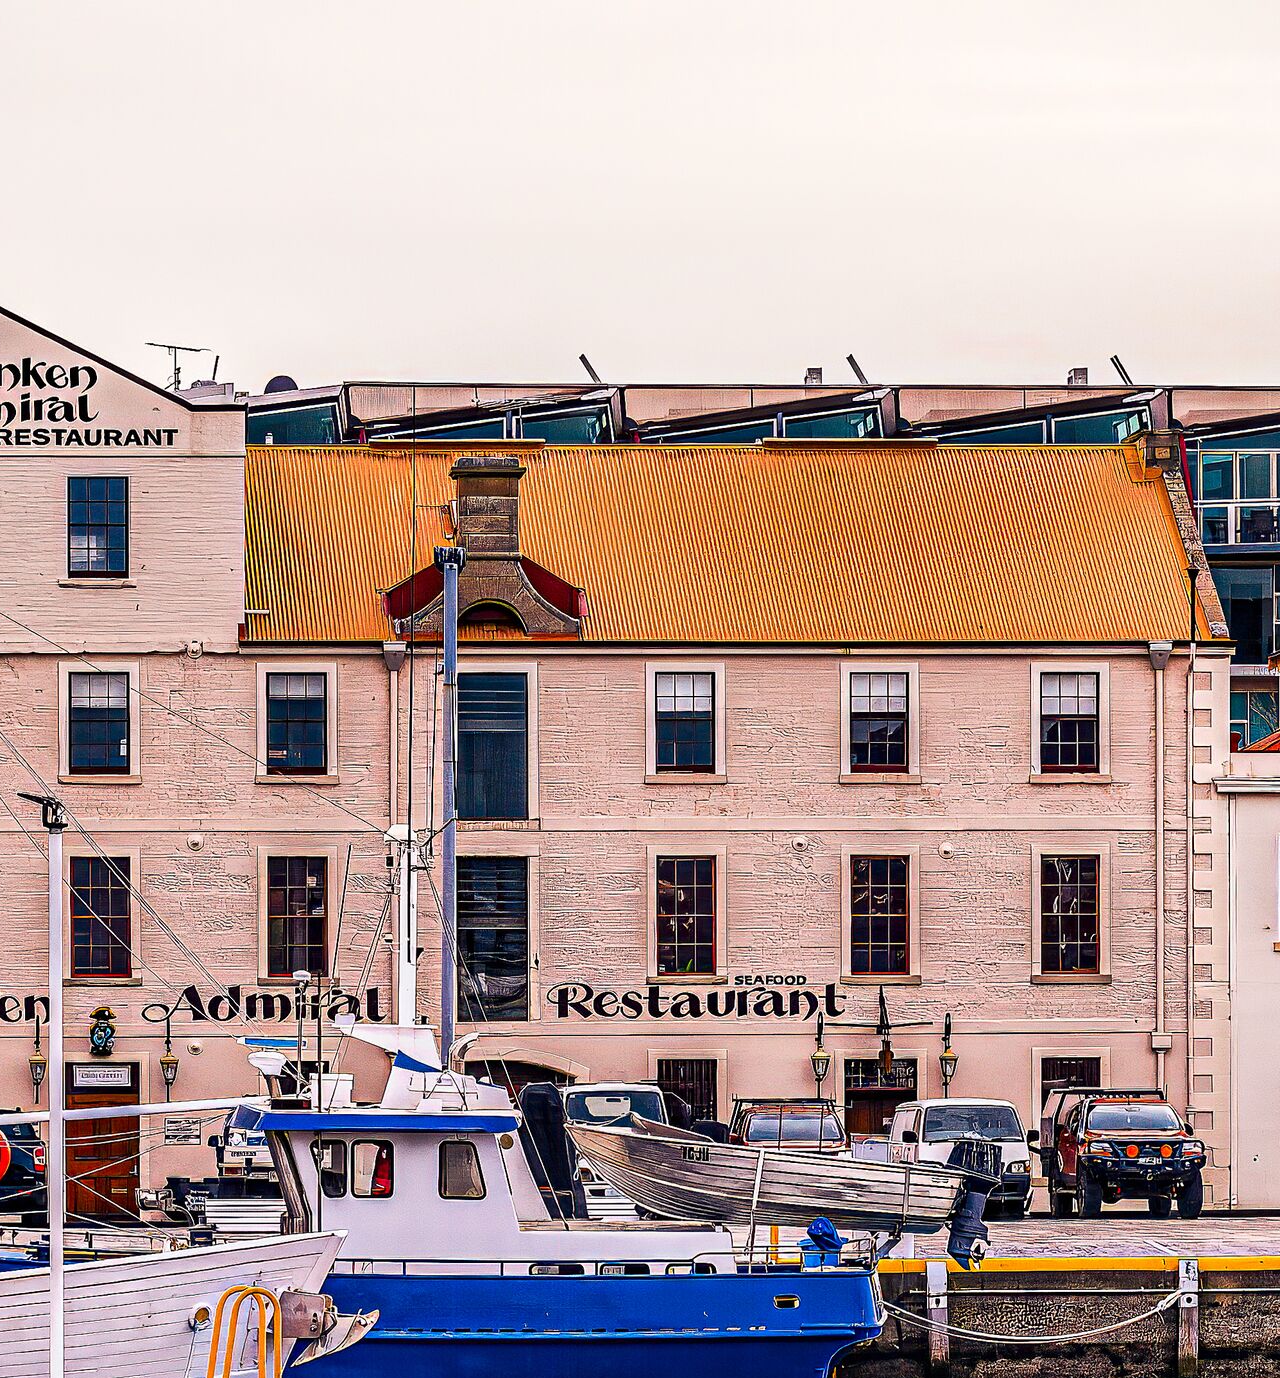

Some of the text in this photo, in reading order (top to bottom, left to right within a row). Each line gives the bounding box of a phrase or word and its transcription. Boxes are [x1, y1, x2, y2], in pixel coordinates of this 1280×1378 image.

[734, 975, 807, 986] SEAFOOD
[141, 985, 388, 1023] Admiral
[546, 982, 847, 1021] Restaurant
